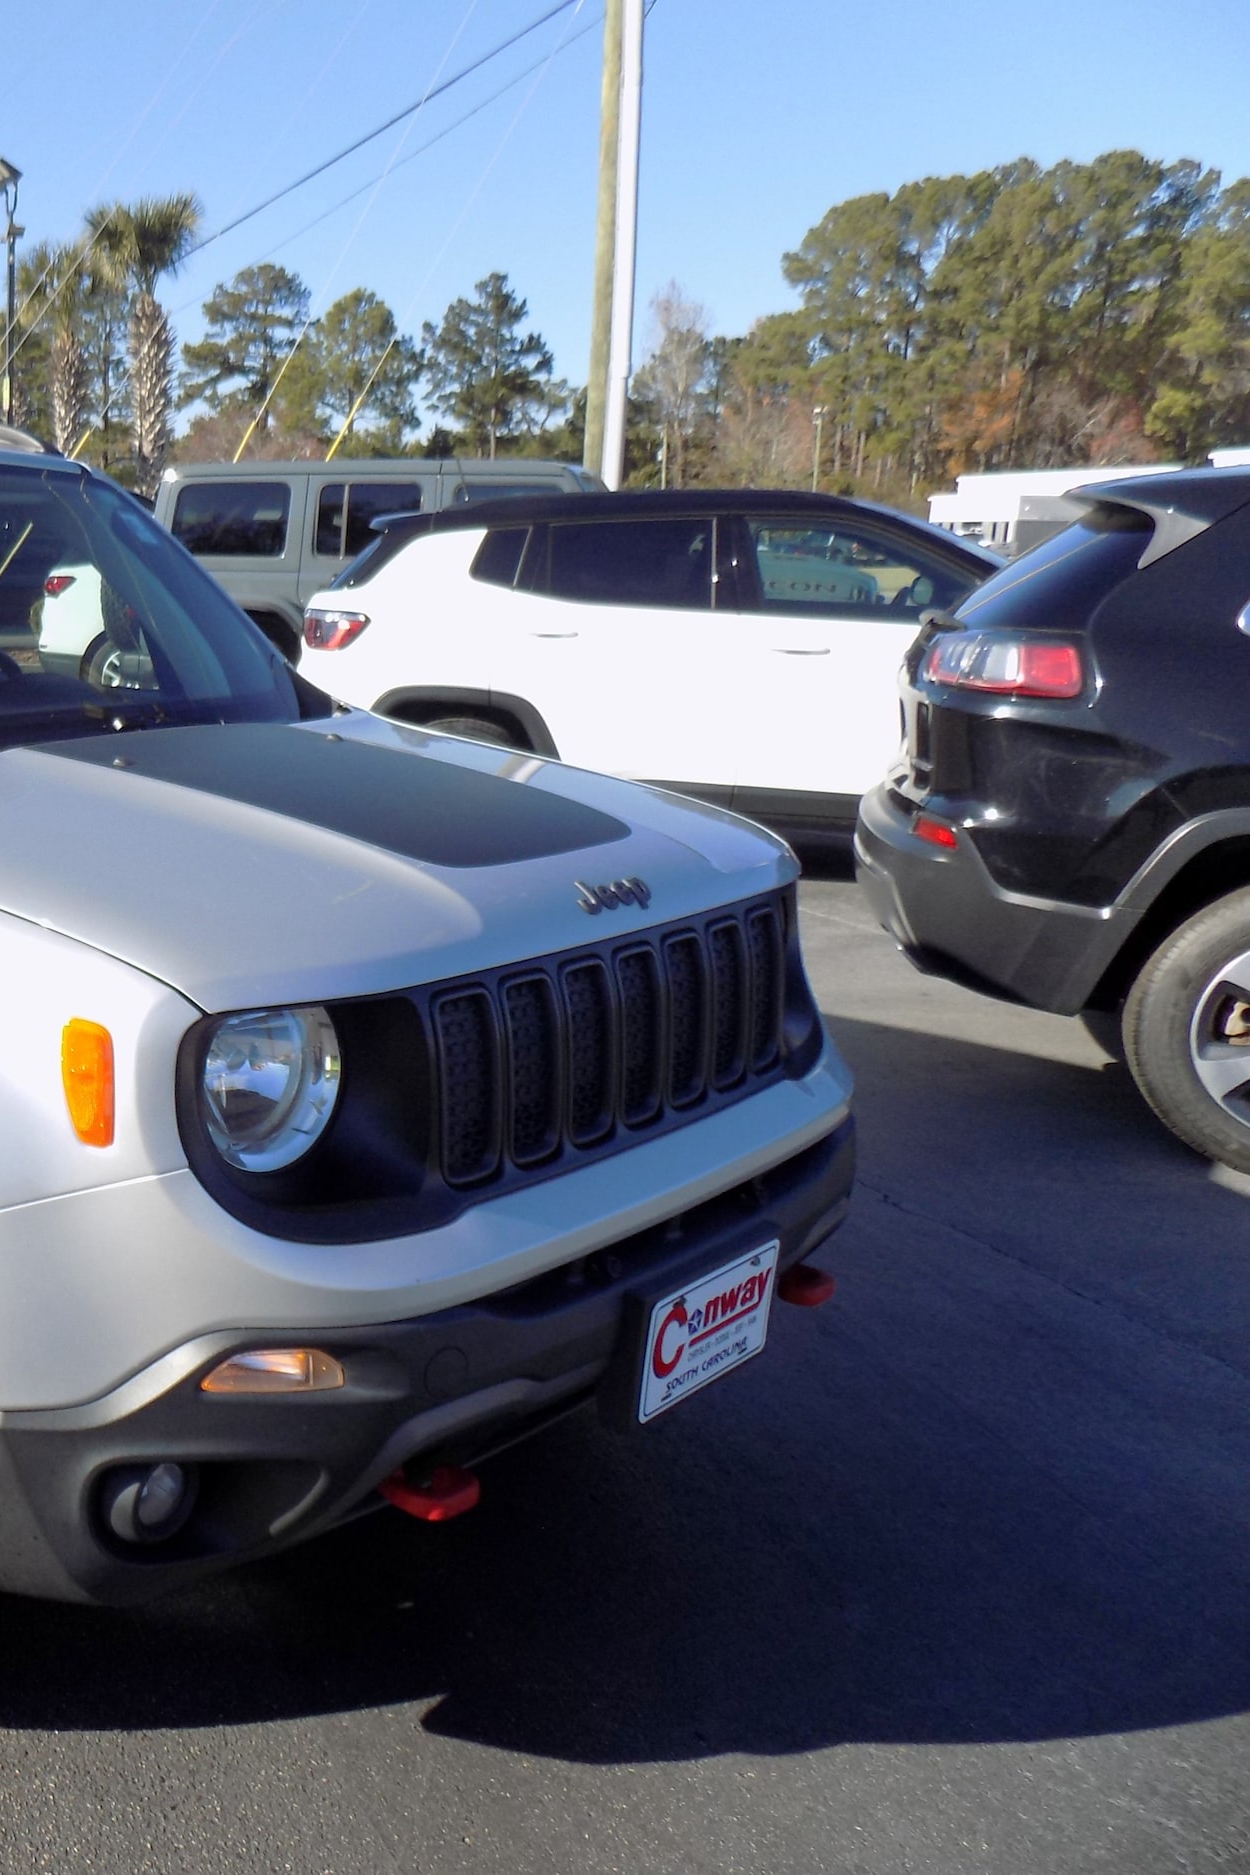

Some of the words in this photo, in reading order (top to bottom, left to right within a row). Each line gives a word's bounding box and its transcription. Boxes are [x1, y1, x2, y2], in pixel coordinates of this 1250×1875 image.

[574, 876, 652, 916] Jeep
[665, 1364, 699, 1393] SOUTH
[701, 1335, 748, 1372] CAROLINA
